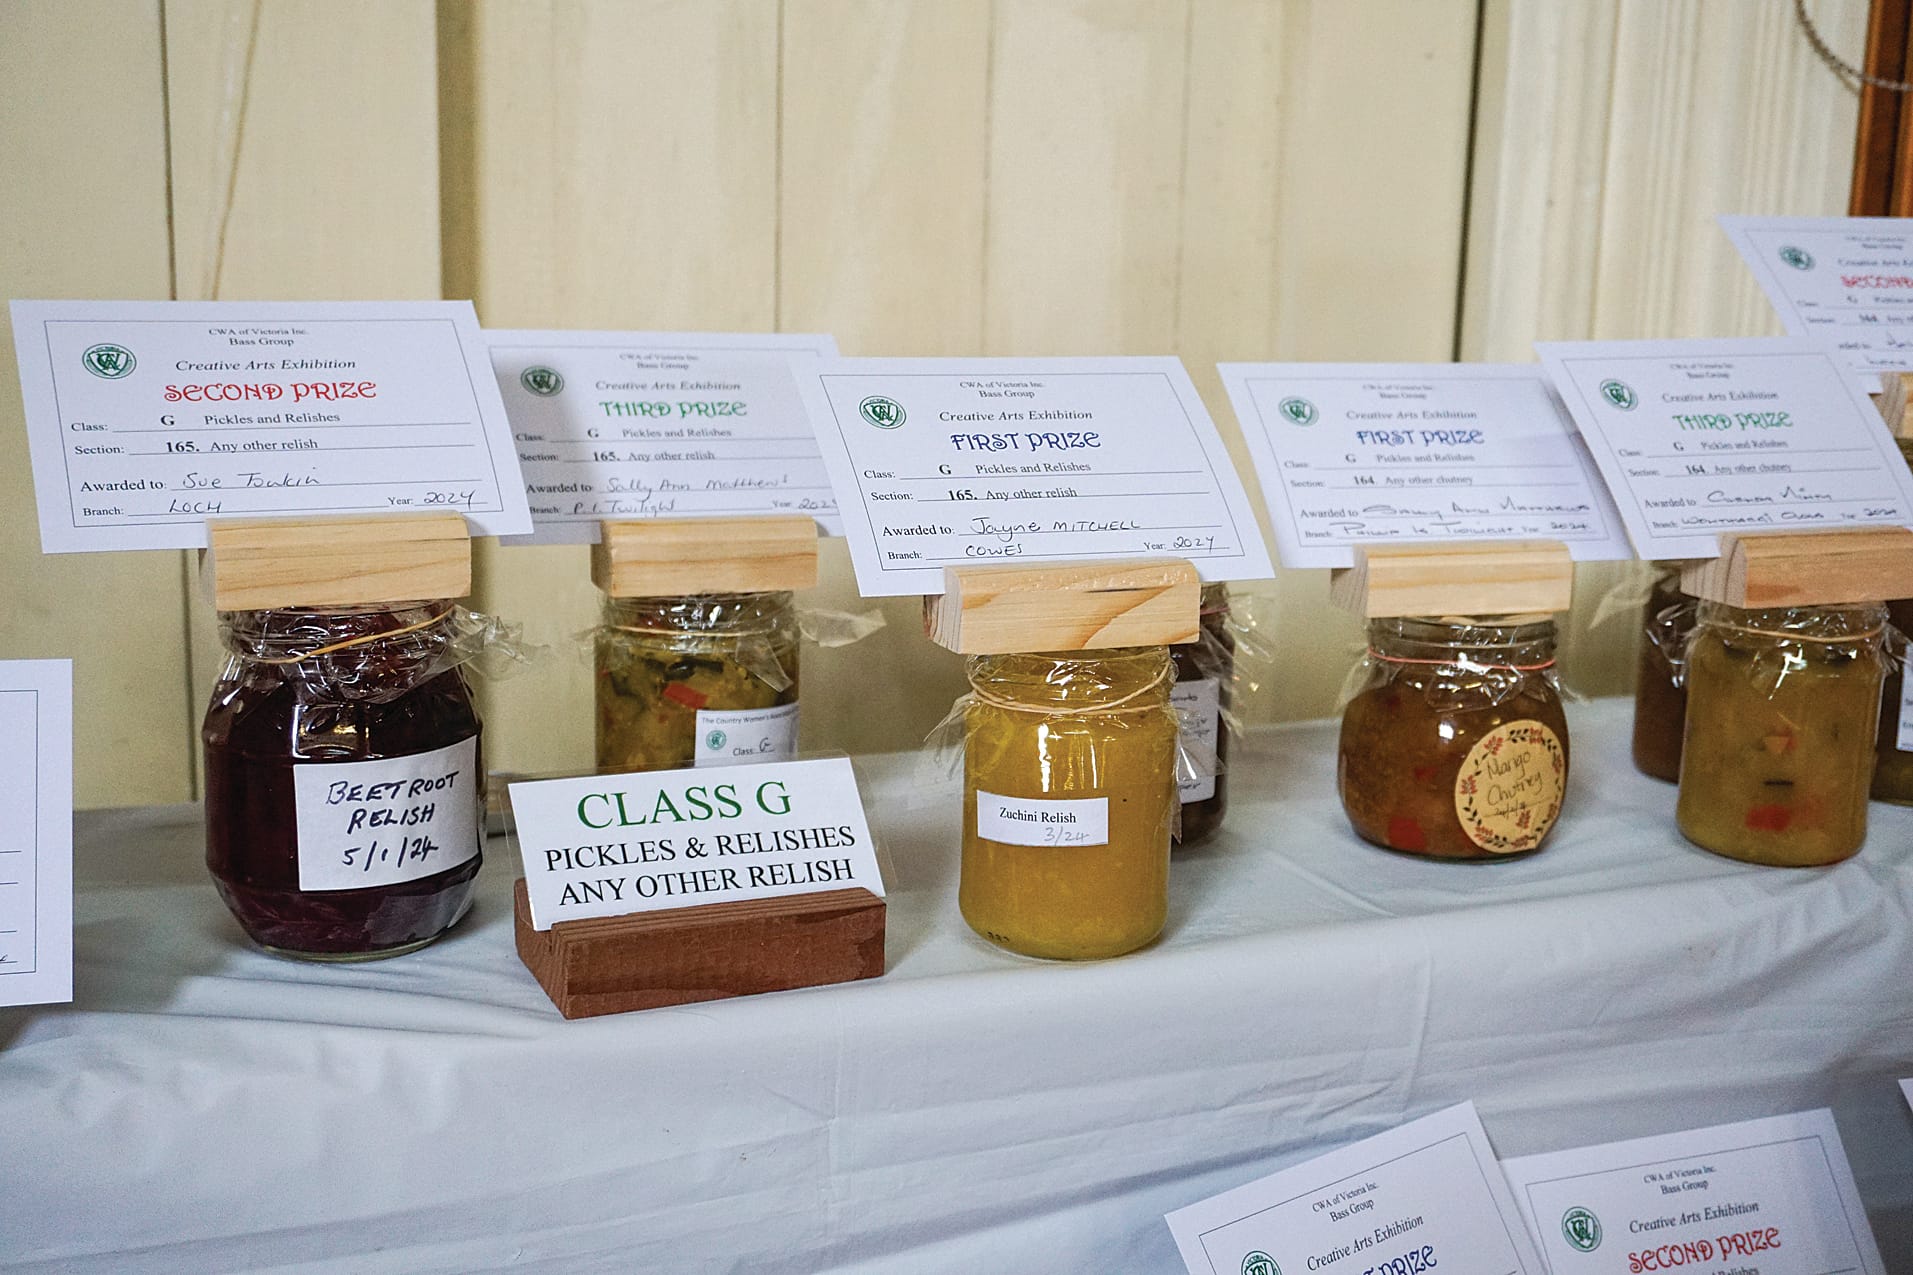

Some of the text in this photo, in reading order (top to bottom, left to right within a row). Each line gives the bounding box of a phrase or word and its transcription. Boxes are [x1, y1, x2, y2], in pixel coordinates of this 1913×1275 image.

[208, 328, 238, 336] CWA
[239, 328, 251, 336] of
[252, 328, 289, 336] Victoria
[229, 337, 295, 348] Bass Group
[175, 358, 356, 372] Creative Arts Exhibition
[163, 380, 377, 403] SECOND PRIZE
[595, 381, 741, 391] Creative Arts Exhibition
[959, 381, 984, 389] CWA
[985, 380, 995, 389] of
[996, 381, 1029, 389] Victoria
[978, 389, 1036, 399] Bass Group
[599, 400, 748, 419] THIRD PRIZE
[938, 410, 1093, 422] Creative Arts Exhibition
[1346, 410, 1478, 420] Creative Arts Exhibition
[70, 412, 341, 433] Class: G Pickles and Relishes
[1671, 411, 1794, 431] THIRD PRIZE
[587, 427, 600, 438] G
[621, 428, 662, 438] Pickles
[664, 429, 684, 438] and
[687, 428, 732, 437] Relishes
[950, 431, 1102, 452] FIRST PRIZE
[1356, 429, 1485, 447] FIRST PRIZE
[74, 439, 319, 456] Section: 165. Any other relish
[592, 451, 621, 462] 165.
[628, 452, 650, 463] Any
[654, 451, 682, 462] other
[685, 451, 716, 461] relish
[863, 462, 1092, 479] Class: G Pickles and Relishes
[80, 479, 146, 492] Awarded
[526, 484, 574, 494] Awarded
[1385, 476, 1406, 487] Any
[1408, 475, 1433, 484] other
[83, 507, 124, 517] Branch:
[388, 495, 414, 506] Year:
[423, 489, 476, 511] 2024
[870, 487, 1078, 502] Section: 165. Any other relish
[1300, 508, 1347, 519] Awarded
[882, 524, 938, 537] Awarded
[970, 516, 1041, 543] Jayne
[888, 551, 923, 561] Branch:
[1143, 541, 1167, 551] Year:
[1172, 535, 1214, 553] 2024
[1487, 751, 1531, 780] Mango
[576, 780, 792, 829] CLASS G
[346, 802, 436, 835] RELISH
[999, 806, 1077, 824] Zuchini Relish
[1043, 825, 1090, 846] 3/24
[544, 824, 857, 873] PICKLES & RELISHES
[558, 858, 856, 907] ANY OTHER RELISH
[1643, 1173, 1665, 1185] CWA
[1665, 1171, 1674, 1181] of
[1674, 1168, 1702, 1180] Victoria
[1660, 1179, 1709, 1195] Bass Group
[1312, 1199, 1333, 1214] CWA
[1332, 1195, 1341, 1205] of
[1340, 1185, 1367, 1201] Victoria
[1329, 1198, 1375, 1223] Bass Group
[1629, 1200, 1760, 1234] Creative Arts Exhibition
[1306, 1214, 1425, 1272] Creative Arts Exhibition
[1628, 1227, 1782, 1274] SECOND PRIZE
